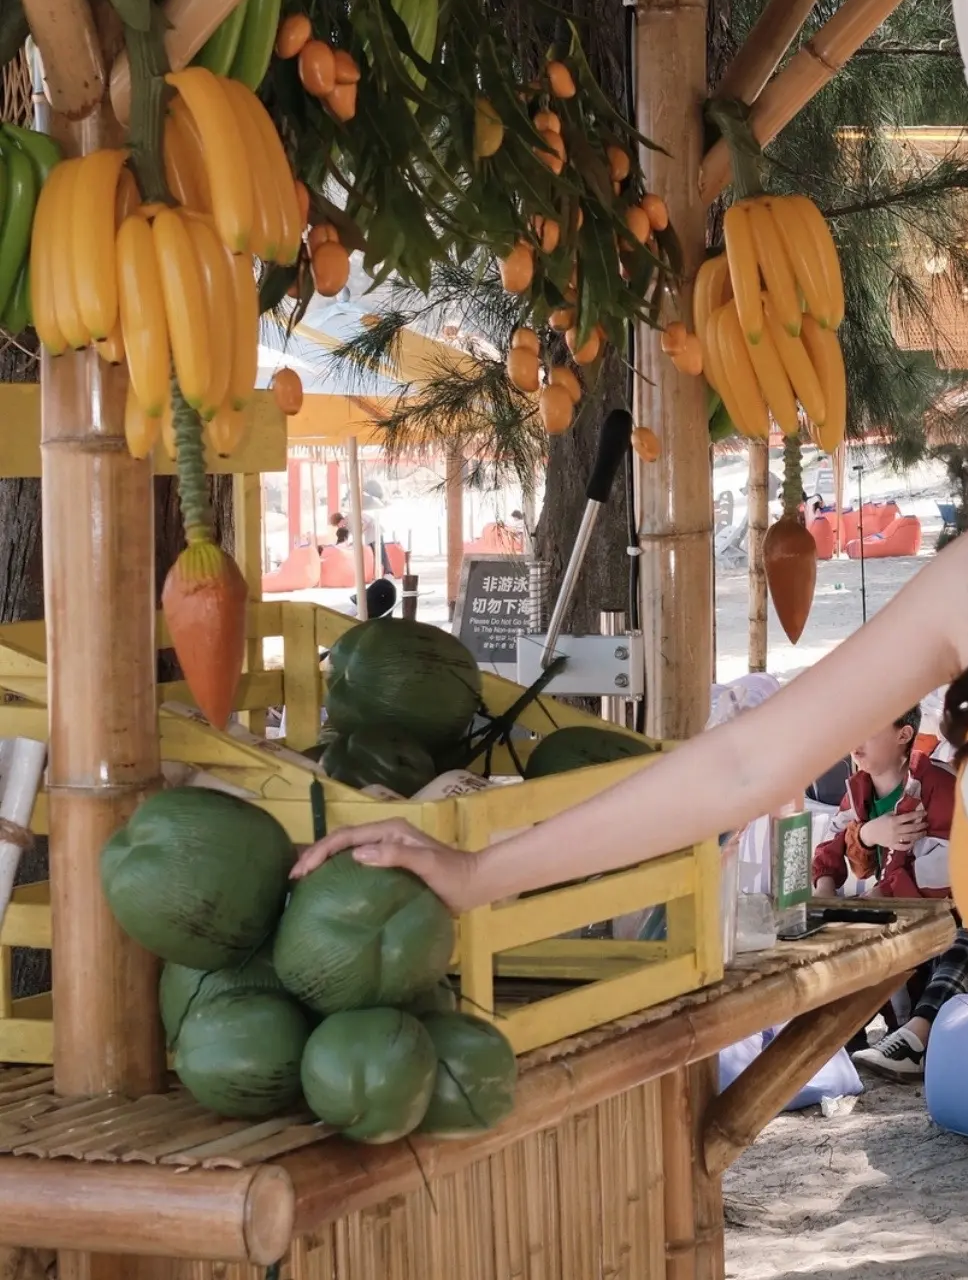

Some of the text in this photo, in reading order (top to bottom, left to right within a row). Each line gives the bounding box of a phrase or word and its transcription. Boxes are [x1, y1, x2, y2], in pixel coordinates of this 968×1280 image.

[491, 618, 500, 626] Do
[501, 618, 512, 626] Not
[513, 618, 522, 626] Go
